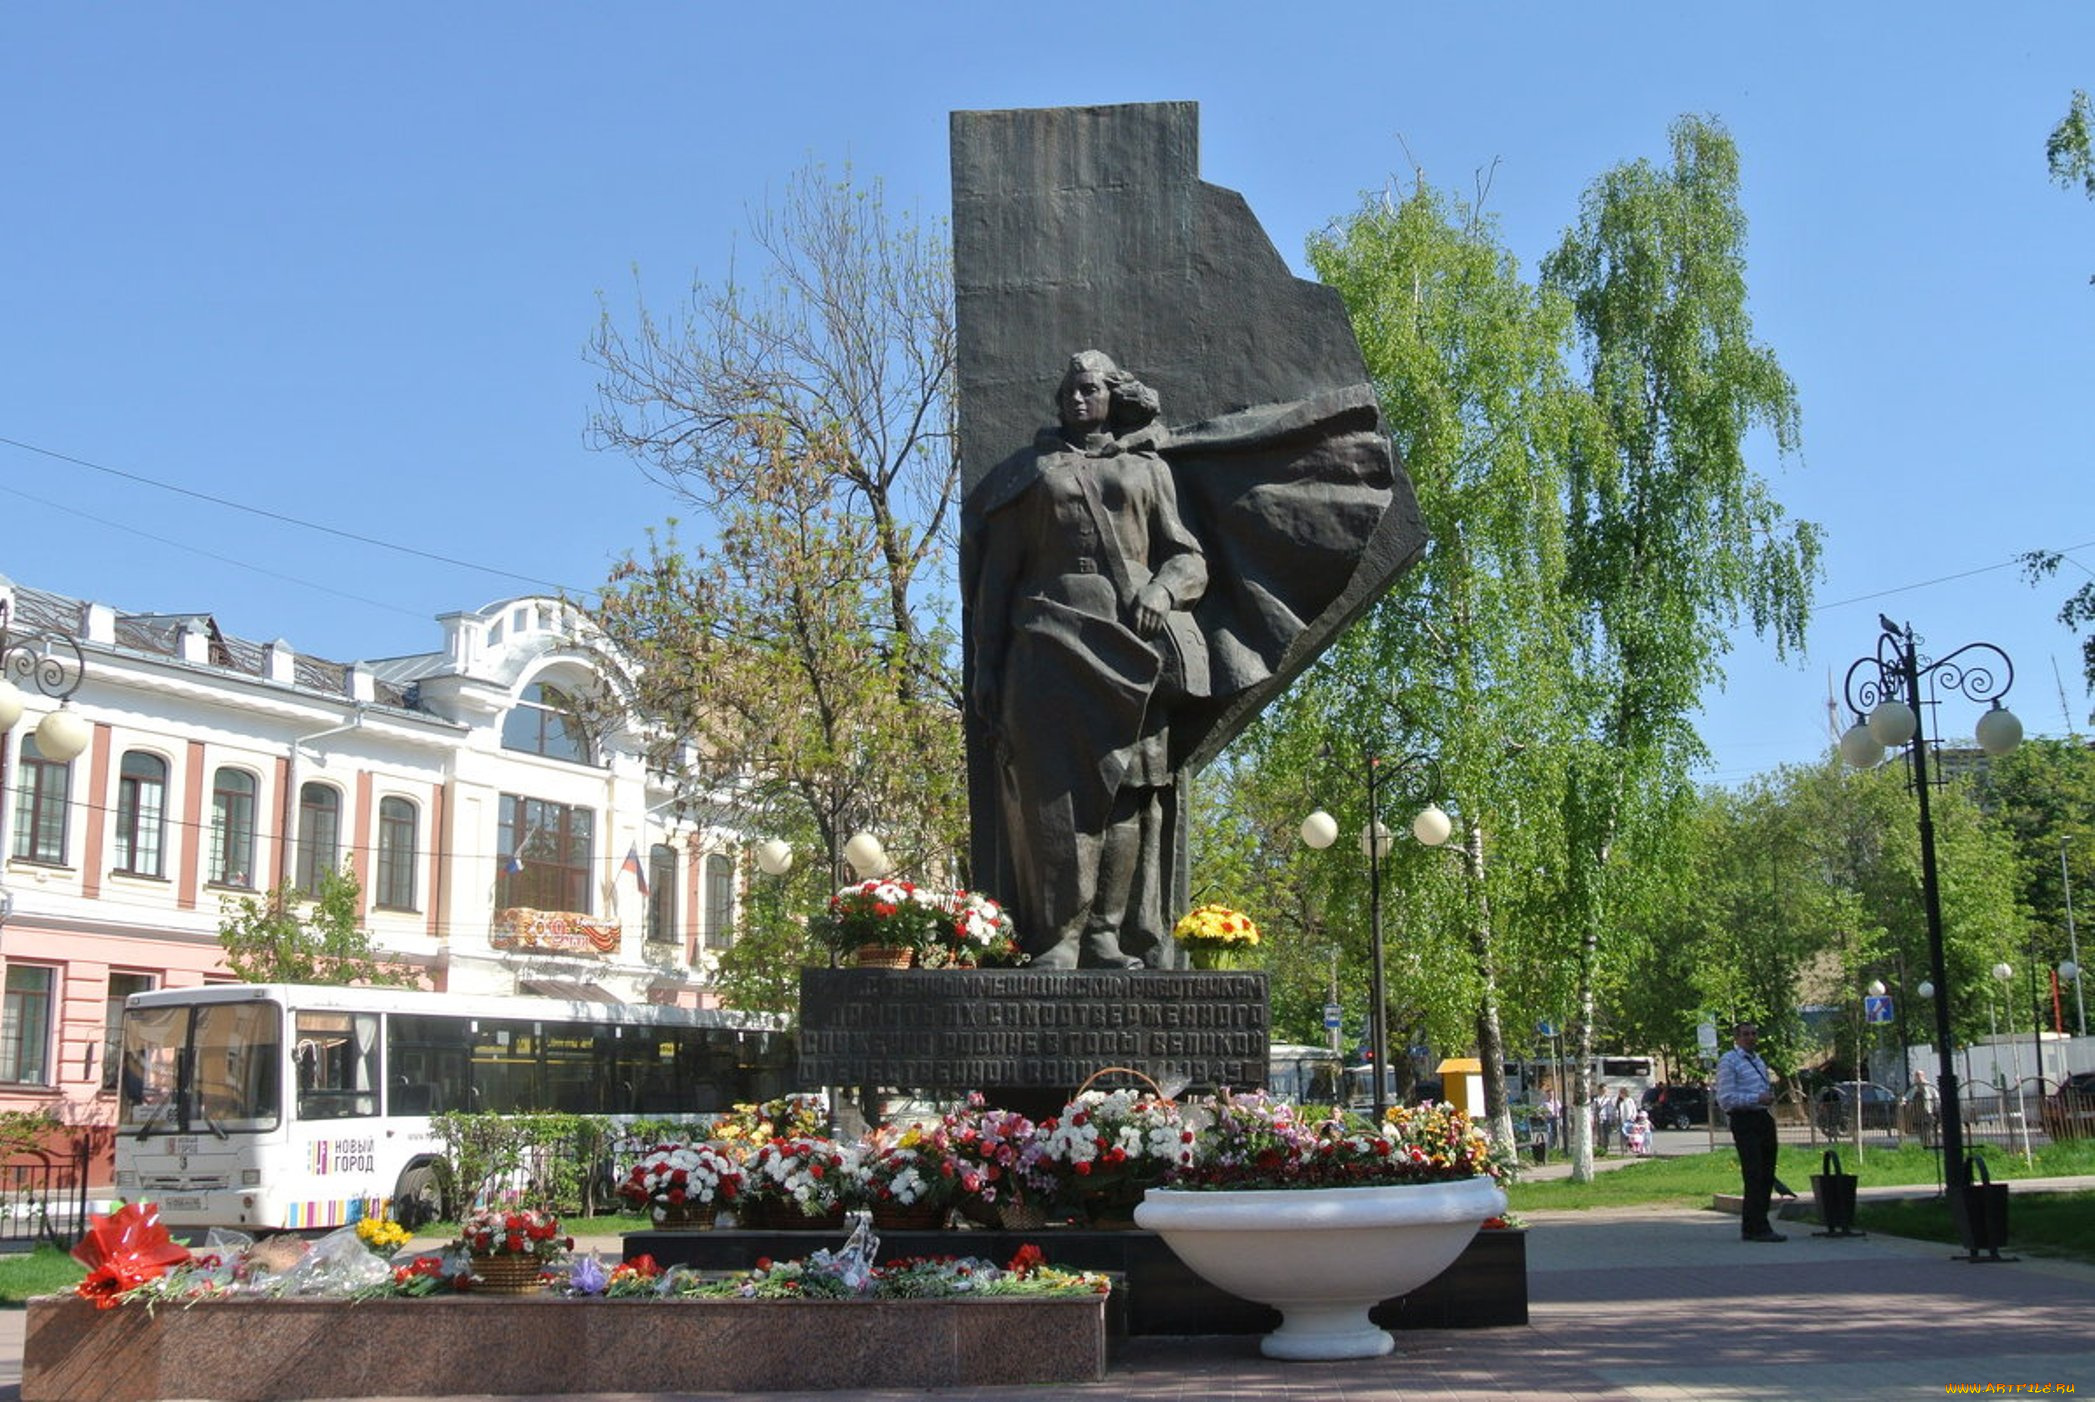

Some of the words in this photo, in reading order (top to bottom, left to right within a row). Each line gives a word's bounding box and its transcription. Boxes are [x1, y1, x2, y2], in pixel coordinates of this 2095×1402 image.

[976, 975, 1130, 997] МЕДИЦИНСКИМ
[1131, 976, 1265, 998] РАБОТНИКАМ
[986, 1003, 1265, 1027] САМООТВЕРЖЕННОГО
[943, 1031, 1039, 1057] РОДИНЕ
[1043, 1031, 1059, 1056] В
[1066, 1031, 1142, 1056] ГОДЫ
[1149, 1029, 1265, 1056] ВЕЛИКОЙ
[335, 1136, 375, 1154] НОВЫЙ
[334, 1155, 375, 1173] ГОРОД
